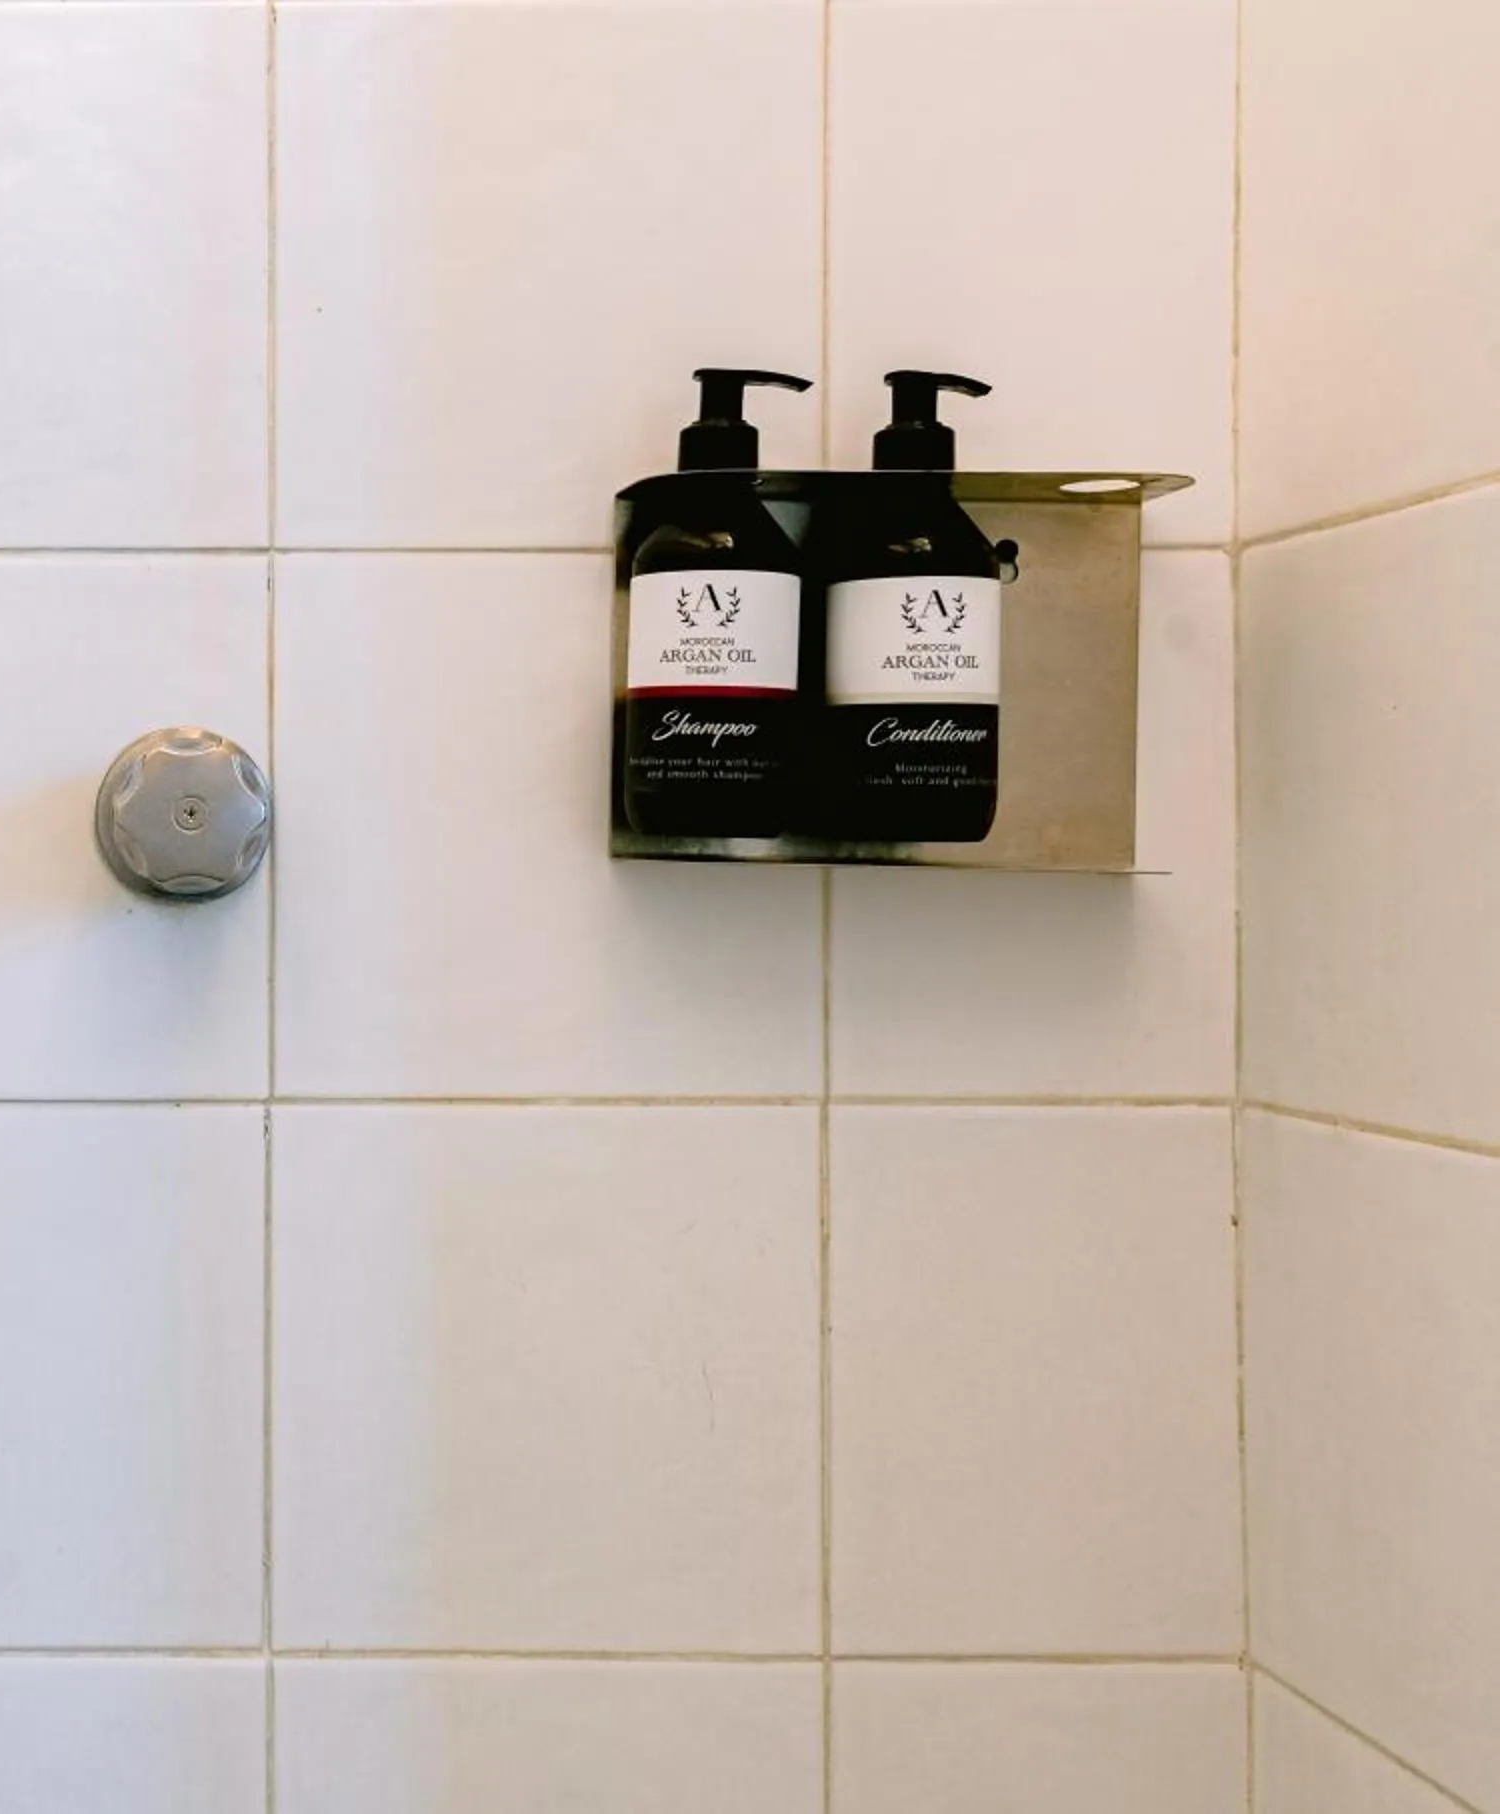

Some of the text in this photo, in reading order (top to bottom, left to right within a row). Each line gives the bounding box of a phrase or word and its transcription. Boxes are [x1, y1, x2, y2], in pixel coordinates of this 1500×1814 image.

[691, 583, 723, 613] A
[919, 589, 950, 619] A
[679, 637, 736, 647] MOROCCAN
[905, 643, 962, 653] MOROCCAN
[659, 649, 757, 663] ARGAN OIL
[881, 655, 980, 669] ARGAN OIL
[685, 665, 729, 675] THERAPY
[911, 671, 957, 681] THERAPY
[651, 709, 759, 748] Shampoo
[866, 717, 989, 747] Conditioner
